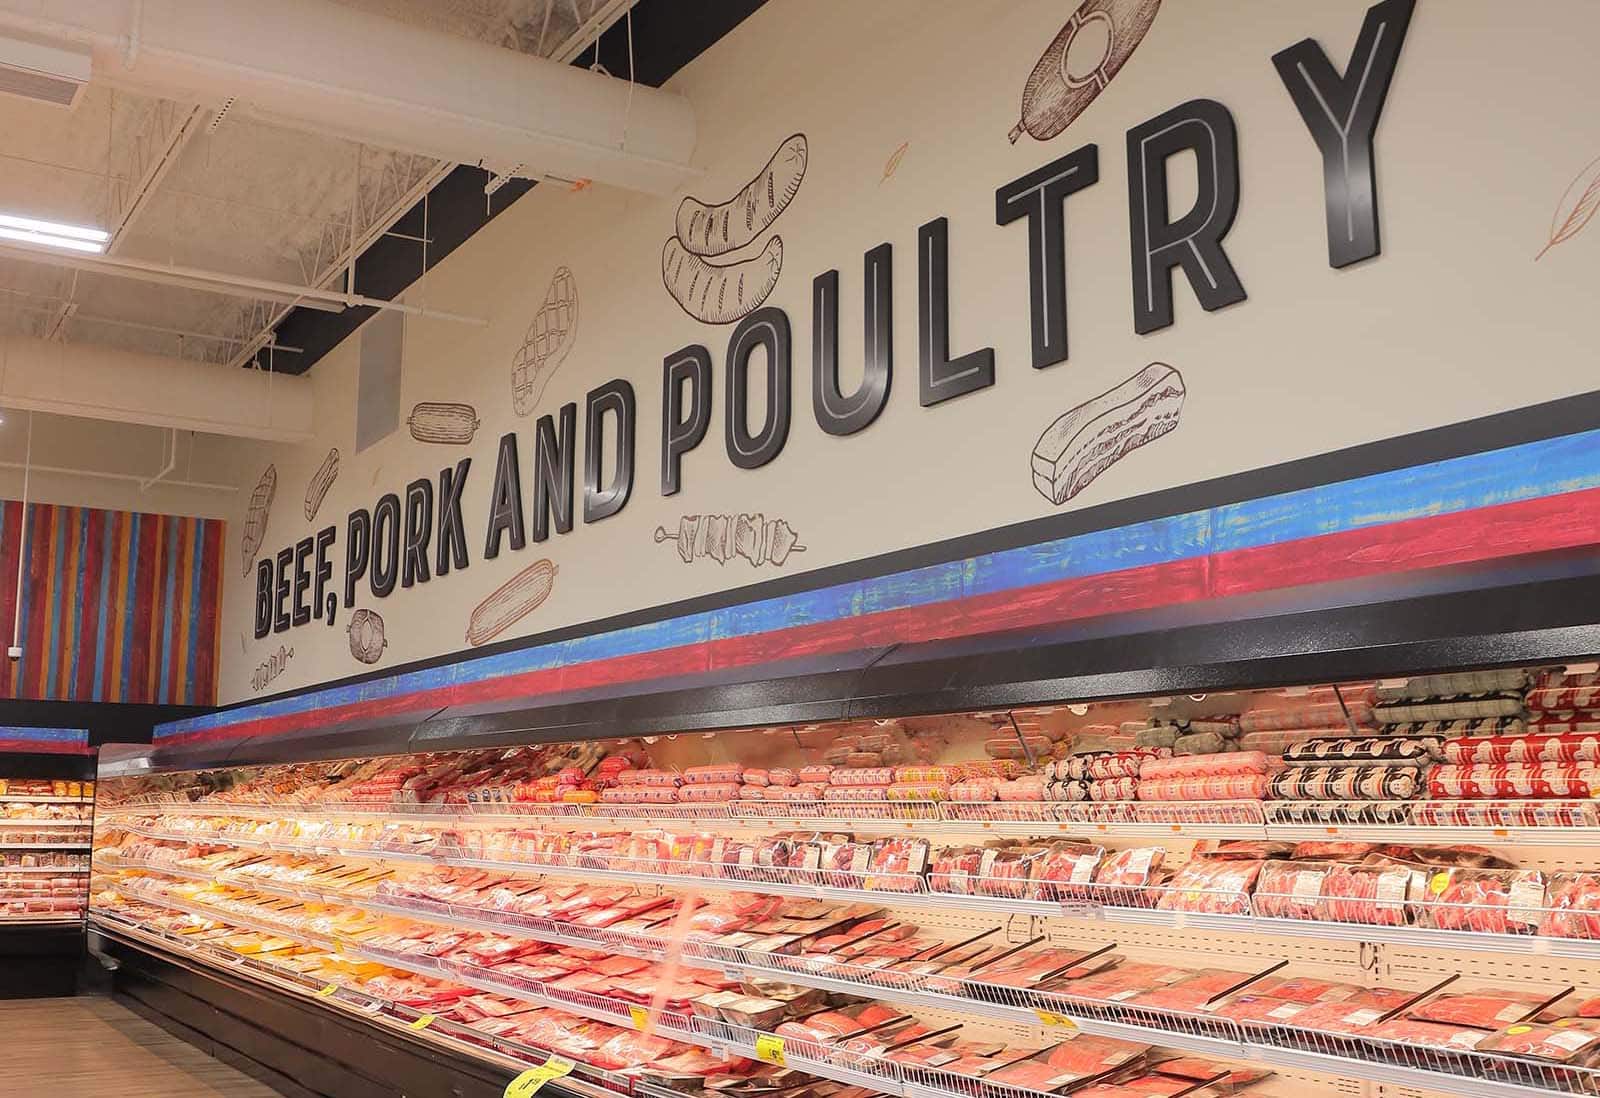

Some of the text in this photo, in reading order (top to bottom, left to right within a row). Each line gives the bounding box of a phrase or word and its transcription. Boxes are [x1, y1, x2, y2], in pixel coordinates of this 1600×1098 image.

[254, 0, 1416, 639] BEEF, PORK AND POULTRY
